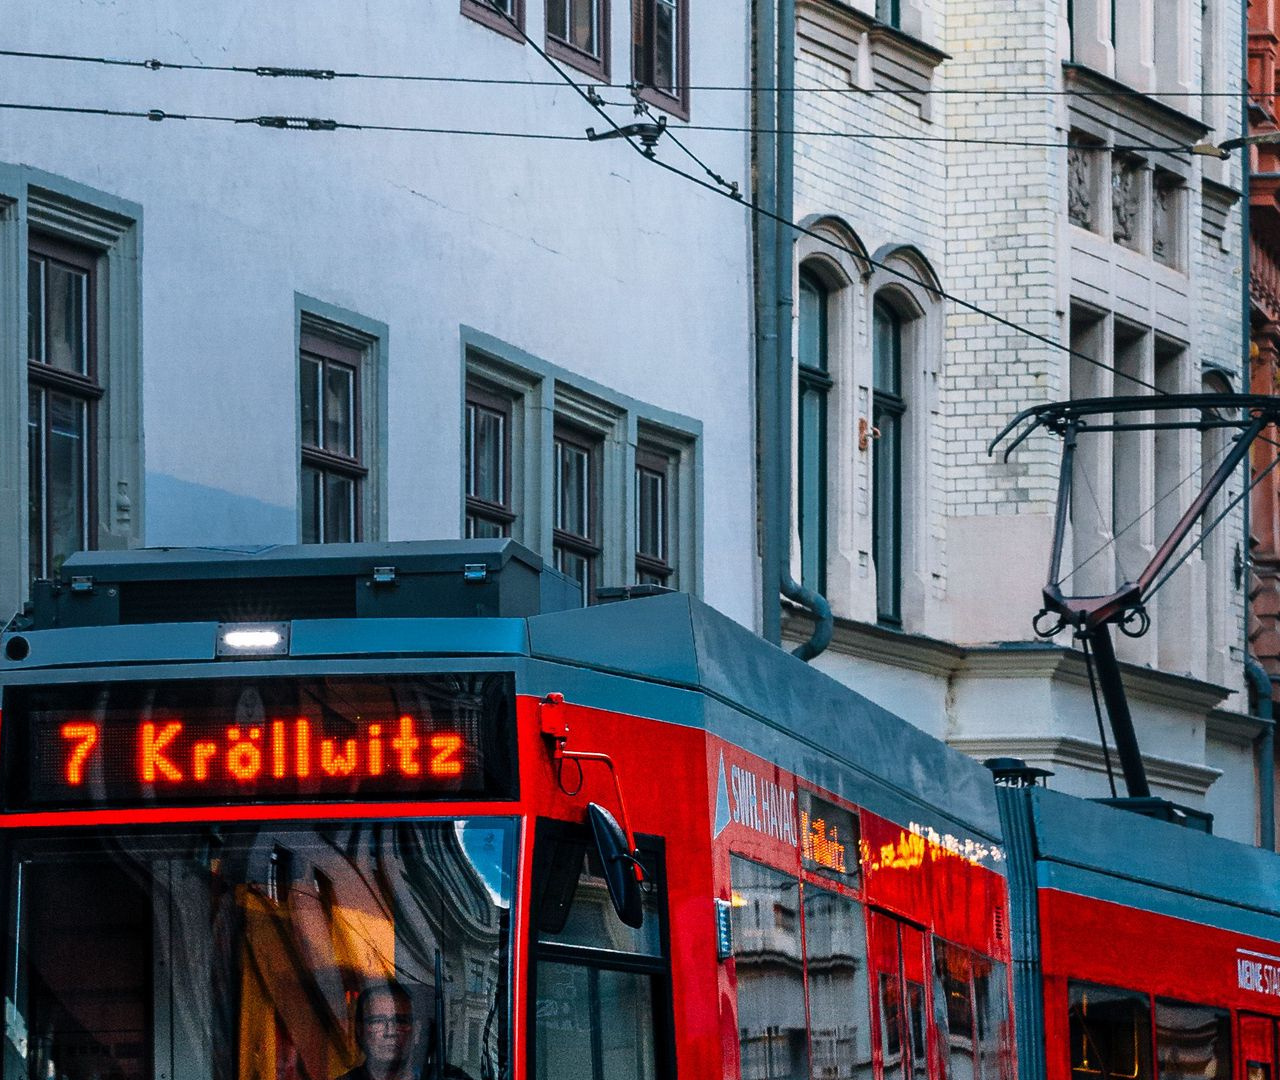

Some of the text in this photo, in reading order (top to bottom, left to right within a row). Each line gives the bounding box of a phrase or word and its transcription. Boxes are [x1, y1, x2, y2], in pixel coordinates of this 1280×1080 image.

[60, 715, 463, 785] 7 Kröllwitz
[1237, 958, 1264, 993] MEINE
